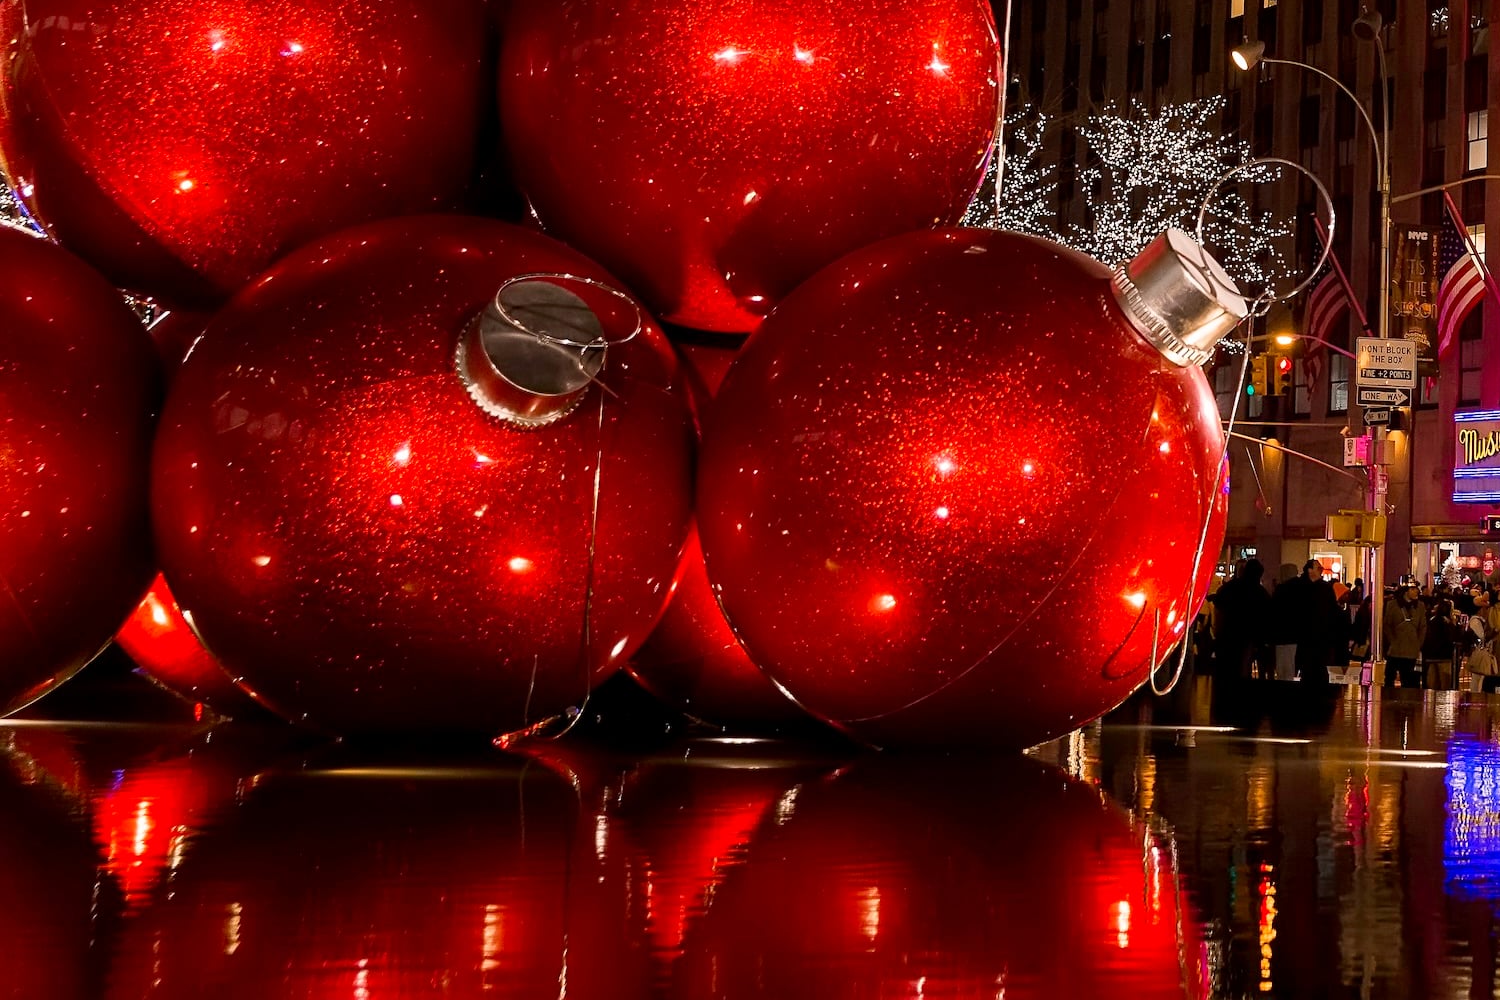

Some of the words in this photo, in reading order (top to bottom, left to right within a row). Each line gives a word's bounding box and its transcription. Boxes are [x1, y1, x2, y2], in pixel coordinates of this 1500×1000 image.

[1408, 231, 1428, 240] NYC
[1405, 280, 1427, 297] THE
[1386, 346, 1412, 355] BLOCK
[1371, 355, 1386, 363] THE
[1387, 356, 1403, 364] BOX
[1377, 370, 1388, 378] +2
[1389, 370, 1411, 379] POINTS
[1365, 392, 1381, 400] ONE
[1387, 393, 1403, 401] WAY
